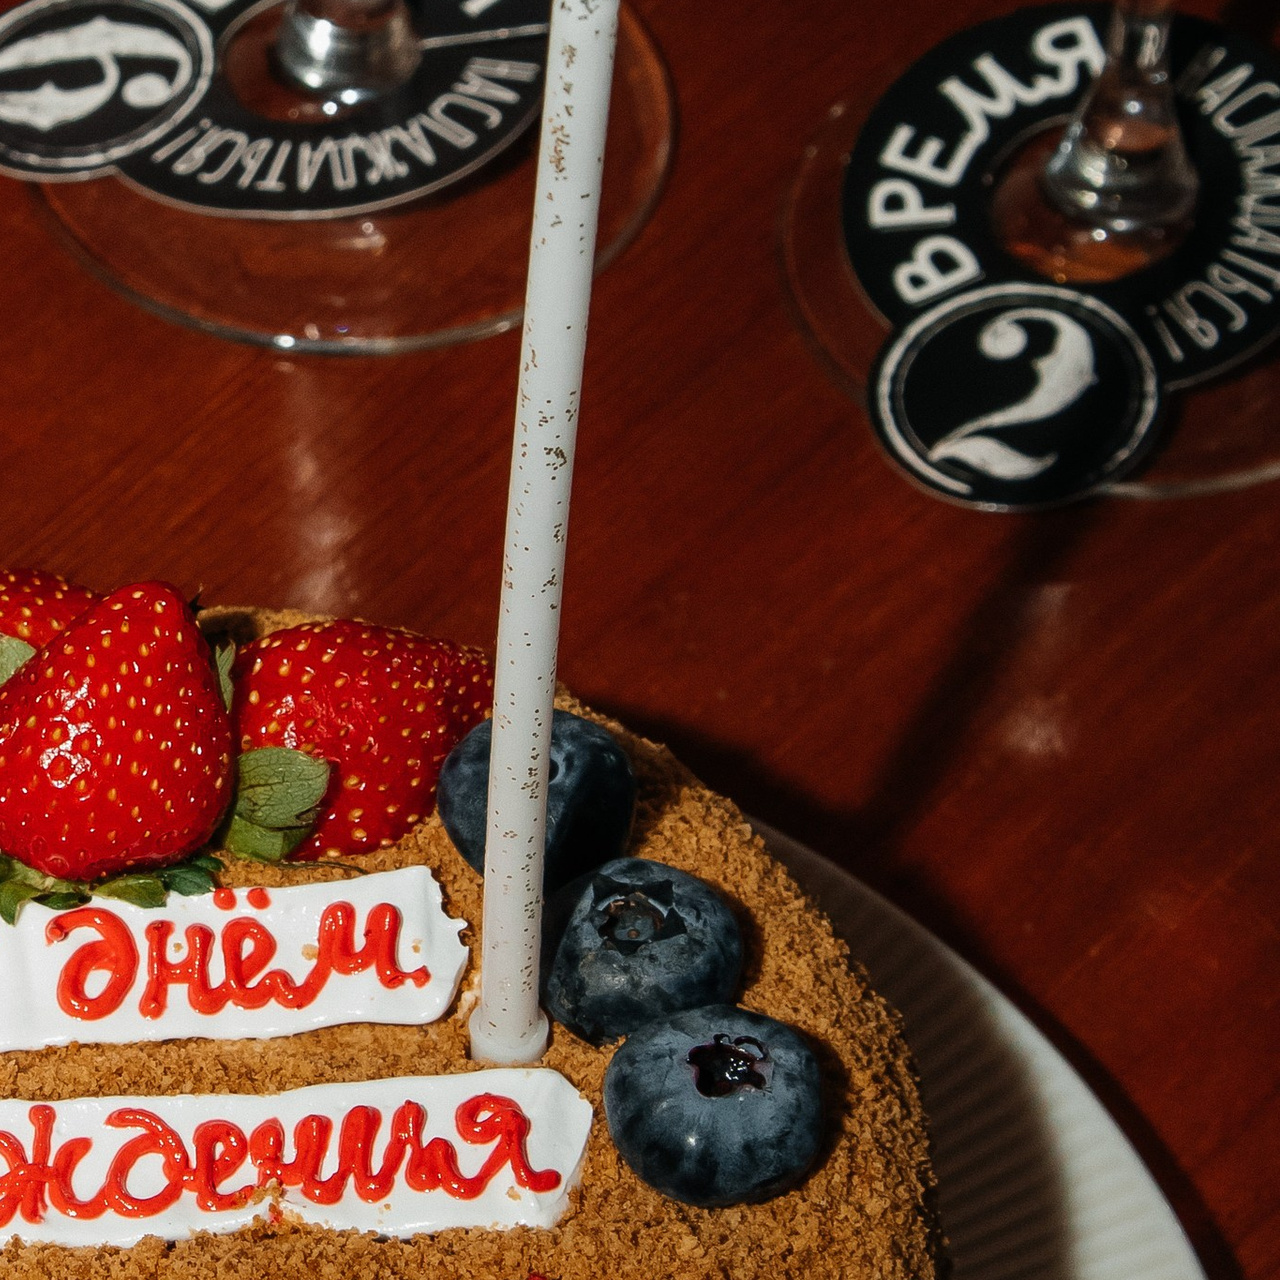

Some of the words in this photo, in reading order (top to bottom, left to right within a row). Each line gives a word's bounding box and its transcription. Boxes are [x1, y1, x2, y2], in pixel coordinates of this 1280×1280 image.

[150, 57, 544, 193] НАСЛАЖДАТЬСЯ!
[868, 16, 1107, 305] ВРЕМЯ
[929, 307, 1098, 480] 2
[46, 887, 432, 1020] днём
